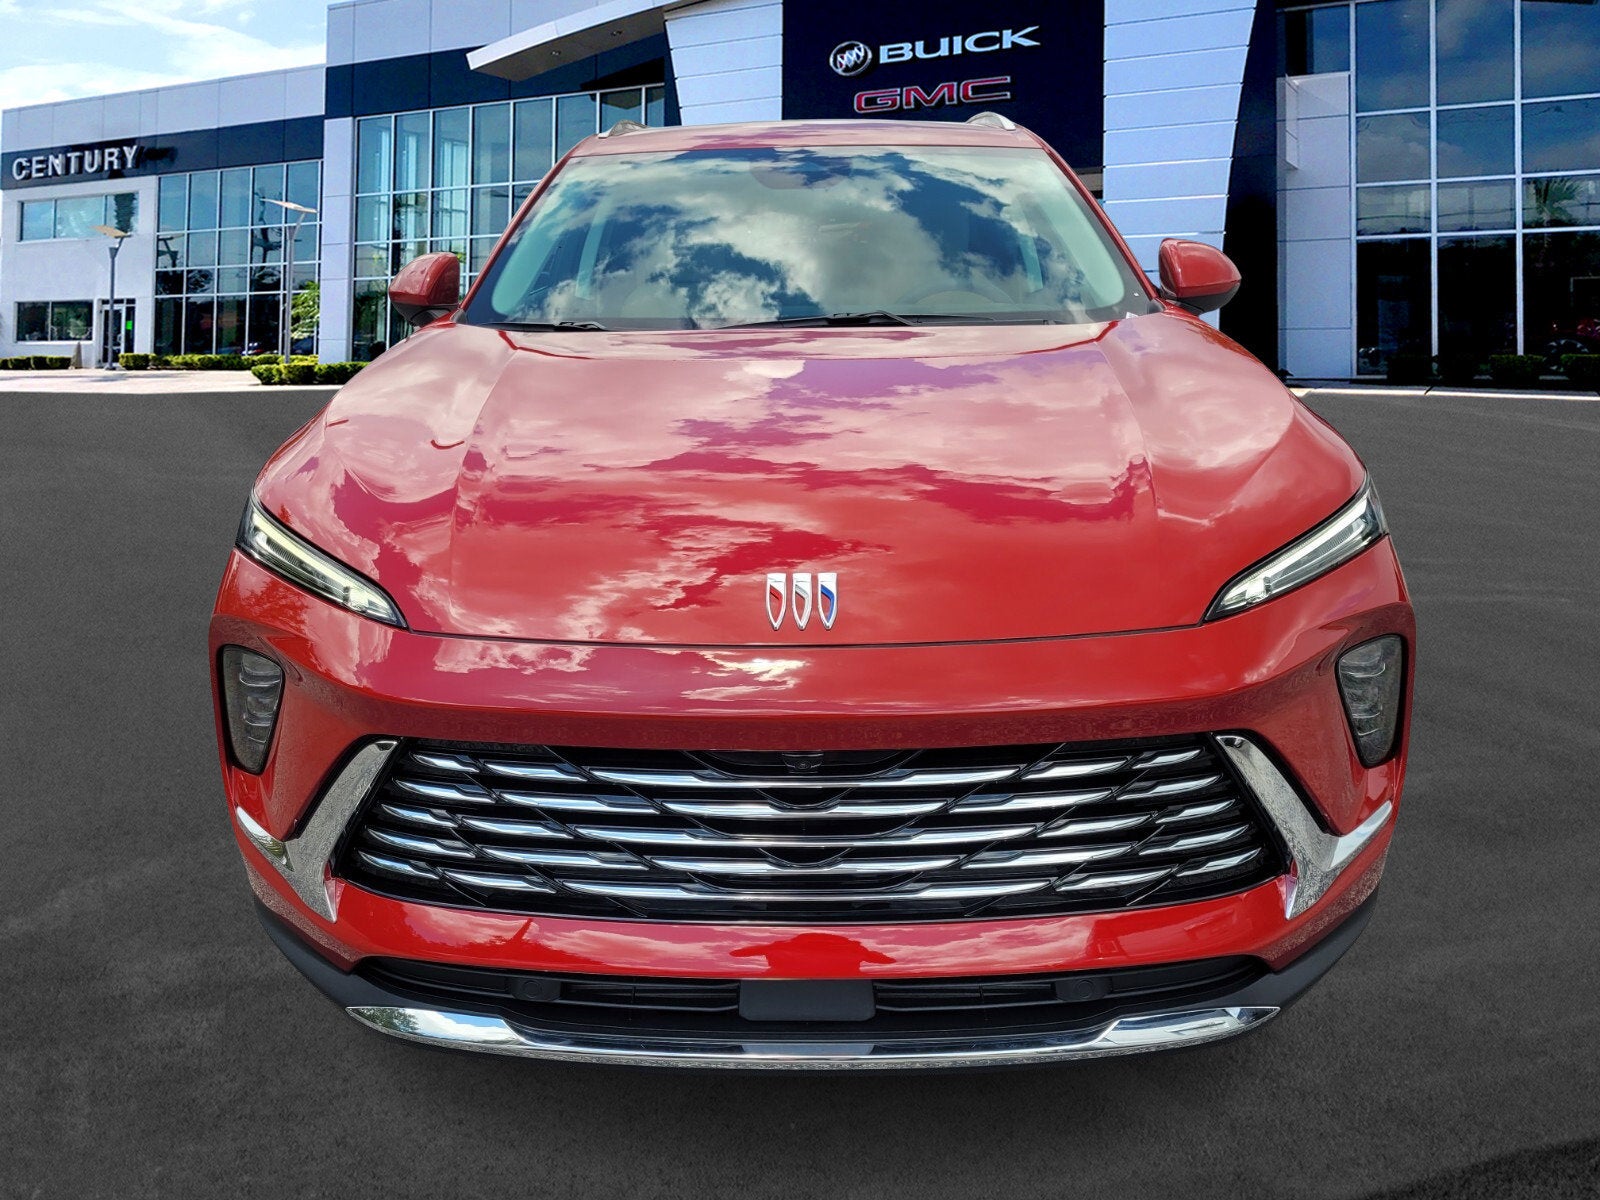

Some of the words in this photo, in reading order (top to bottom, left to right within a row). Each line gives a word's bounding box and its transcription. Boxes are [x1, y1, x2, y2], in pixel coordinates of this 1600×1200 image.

[879, 25, 1040, 63] BUICK
[854, 76, 1011, 113] GMC
[12, 145, 138, 181] CENTURY
